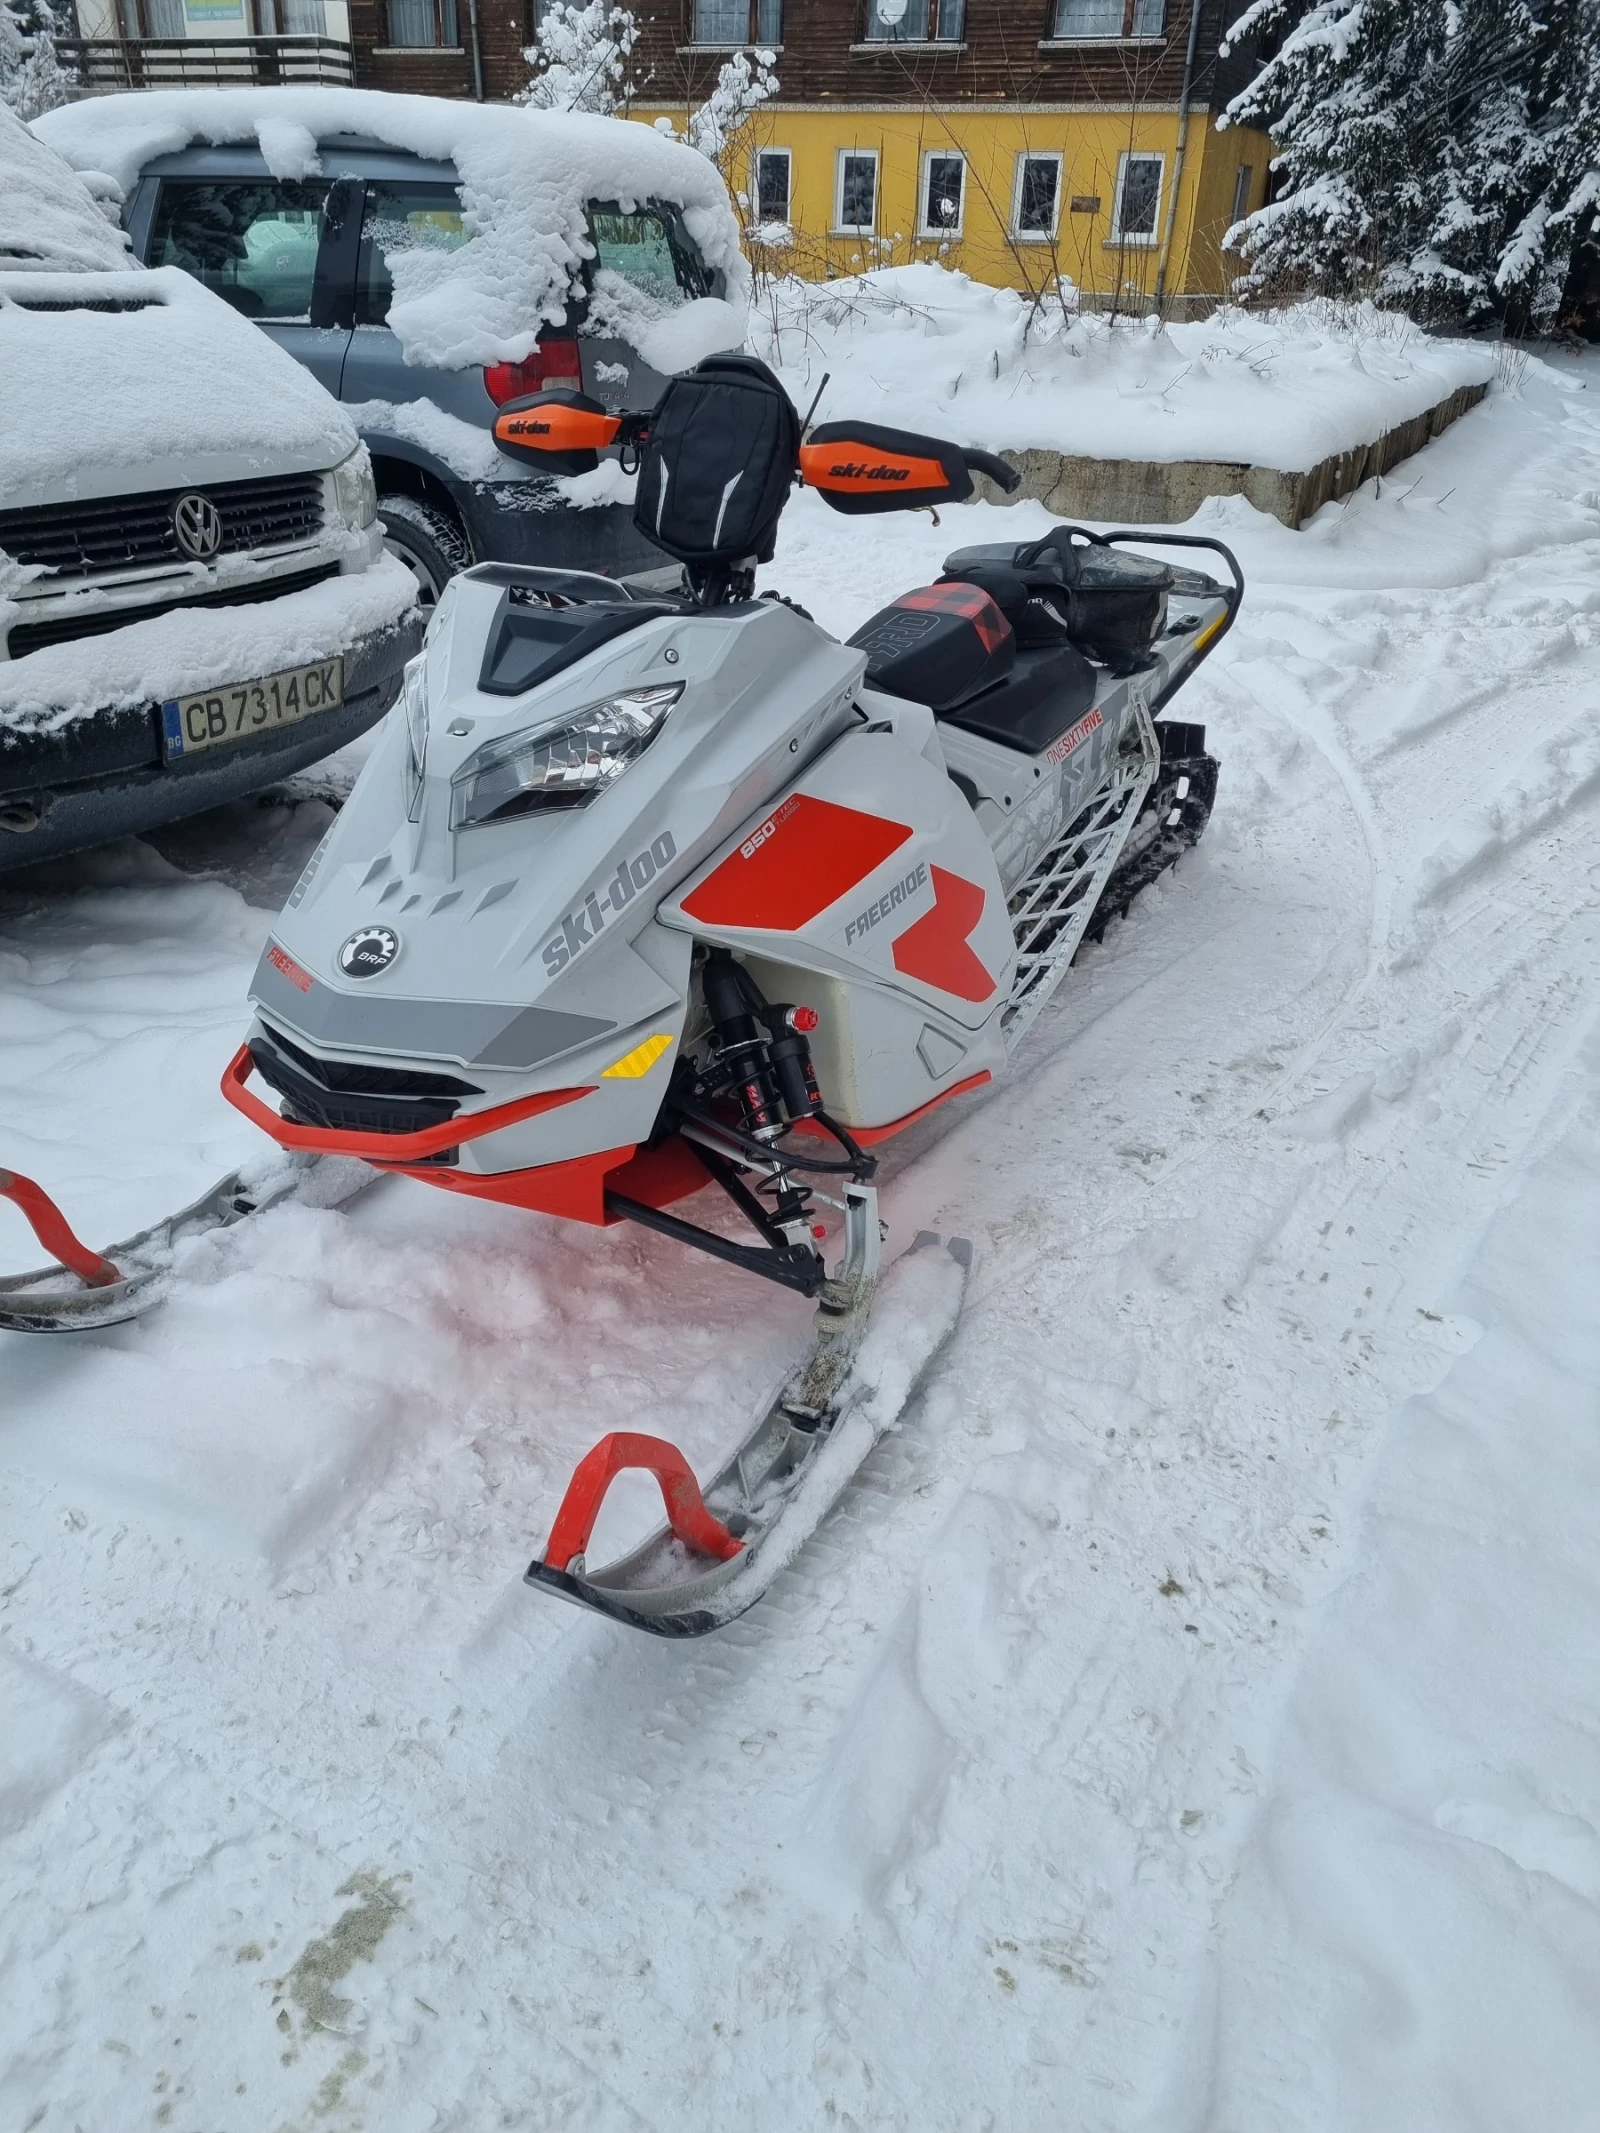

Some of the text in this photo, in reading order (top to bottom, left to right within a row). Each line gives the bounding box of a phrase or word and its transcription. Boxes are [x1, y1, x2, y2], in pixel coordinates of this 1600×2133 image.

[507, 420, 551, 434] ski-doo
[828, 463, 911, 481] ski-doo
[167, 735, 182, 749] BG
[1046, 707, 1104, 766] ONESIXTYFIVE
[740, 820, 776, 860] 850
[541, 830, 678, 978] ski-doo
[357, 951, 388, 966] BRP
